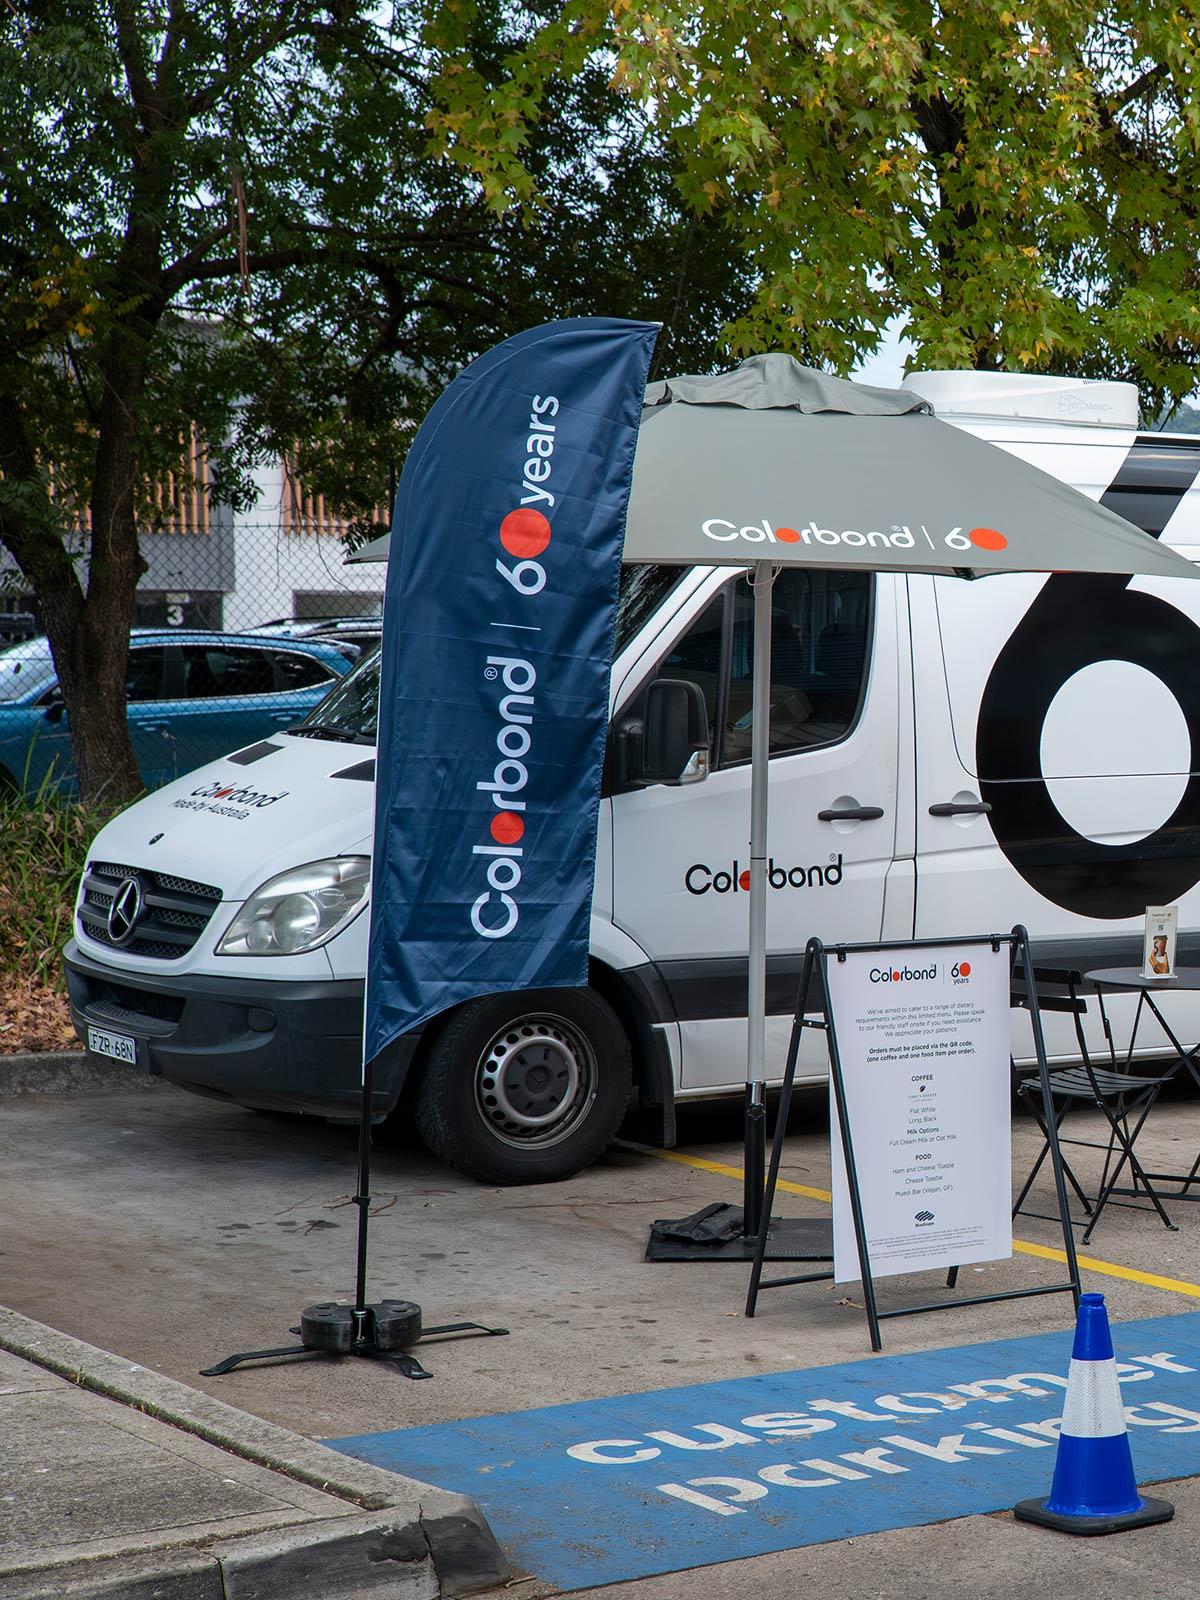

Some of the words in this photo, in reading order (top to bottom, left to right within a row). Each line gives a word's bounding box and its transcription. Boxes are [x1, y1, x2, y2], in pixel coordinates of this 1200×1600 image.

[167, 605, 184, 626] 3
[191, 782, 290, 808] Colorbond
[168, 799, 196, 809] Made
[194, 800, 210, 811] by
[206, 803, 250, 820] Australia
[685, 854, 842, 895] Colobond
[870, 964, 937, 983] Colorbond
[951, 962, 971, 978] 60
[953, 977, 969, 985] years
[867, 1008, 884, 1016] We've
[884, 1007, 901, 1015] aimed
[855, 1016, 890, 1025] requirements
[876, 1022, 896, 1031] friendly
[897, 1021, 909, 1029] staff
[941, 1018, 955, 1026] need
[884, 1030, 894, 1038] We
[894, 1029, 922, 1037] appreciate
[922, 1028, 935, 1036] your
[866, 1055, 879, 1063] (one
[880, 1053, 898, 1061] coffee
[898, 1052, 909, 1060] and
[900, 1138, 917, 1146] Cream
[943, 1184, 953, 1192] GF)
